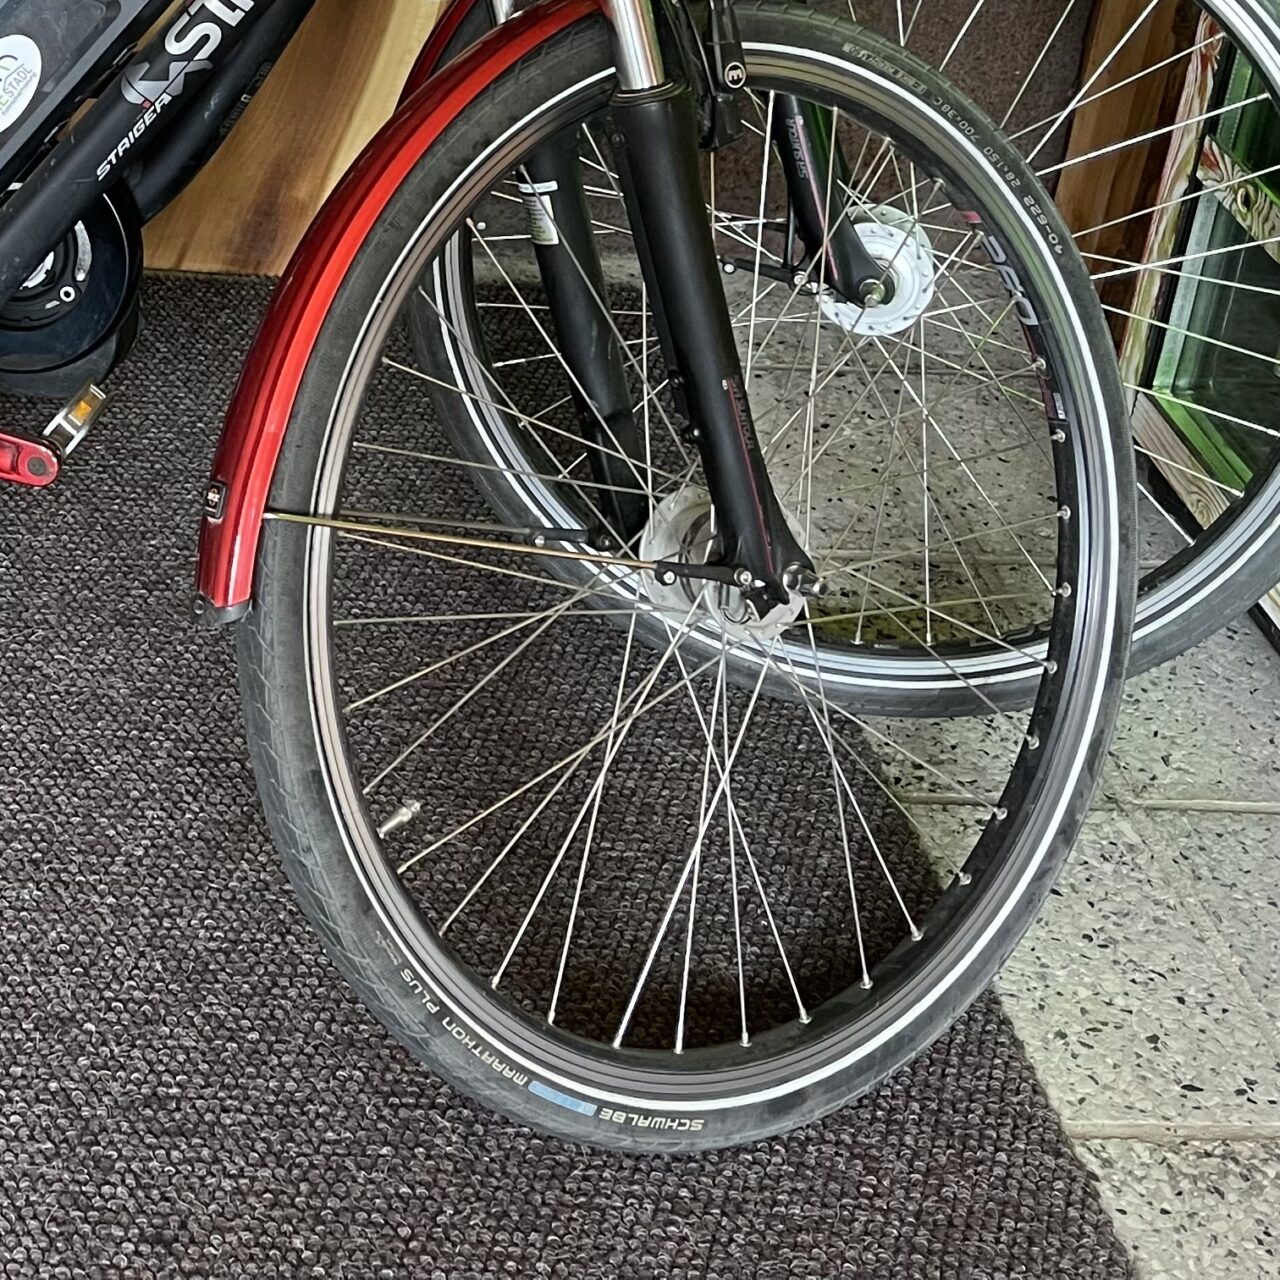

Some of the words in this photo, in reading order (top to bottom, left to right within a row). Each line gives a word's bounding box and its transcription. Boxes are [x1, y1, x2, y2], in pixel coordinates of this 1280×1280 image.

[400, 968, 441, 1015] PLUS
[441, 1016, 528, 1086] MARATHON
[598, 1107, 705, 1132] SCHWALBE
